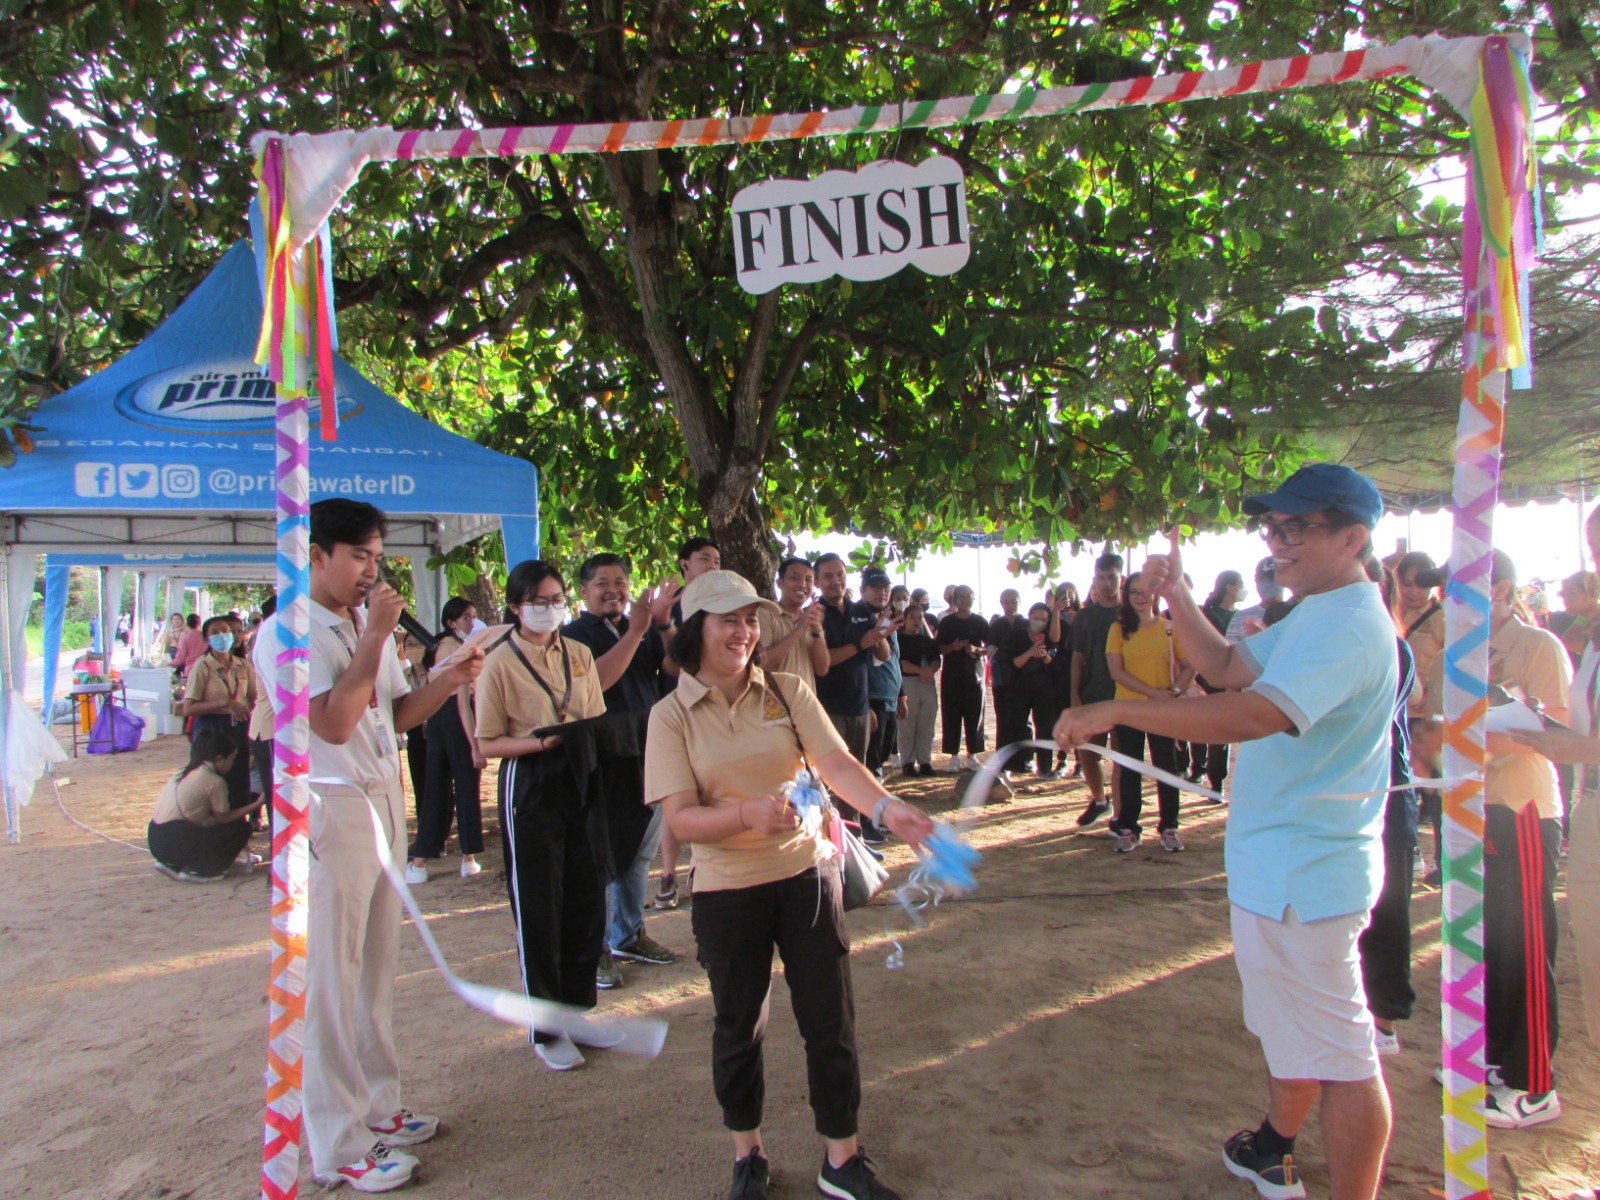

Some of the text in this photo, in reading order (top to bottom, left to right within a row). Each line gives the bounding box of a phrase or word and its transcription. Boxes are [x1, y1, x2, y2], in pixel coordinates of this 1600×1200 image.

[734, 182, 967, 273] FINISH
[190, 371, 223, 381] air
[158, 374, 312, 410] prim
[35, 439, 239, 449] SEGARKAN
[208, 468, 416, 496] @priawaterID
